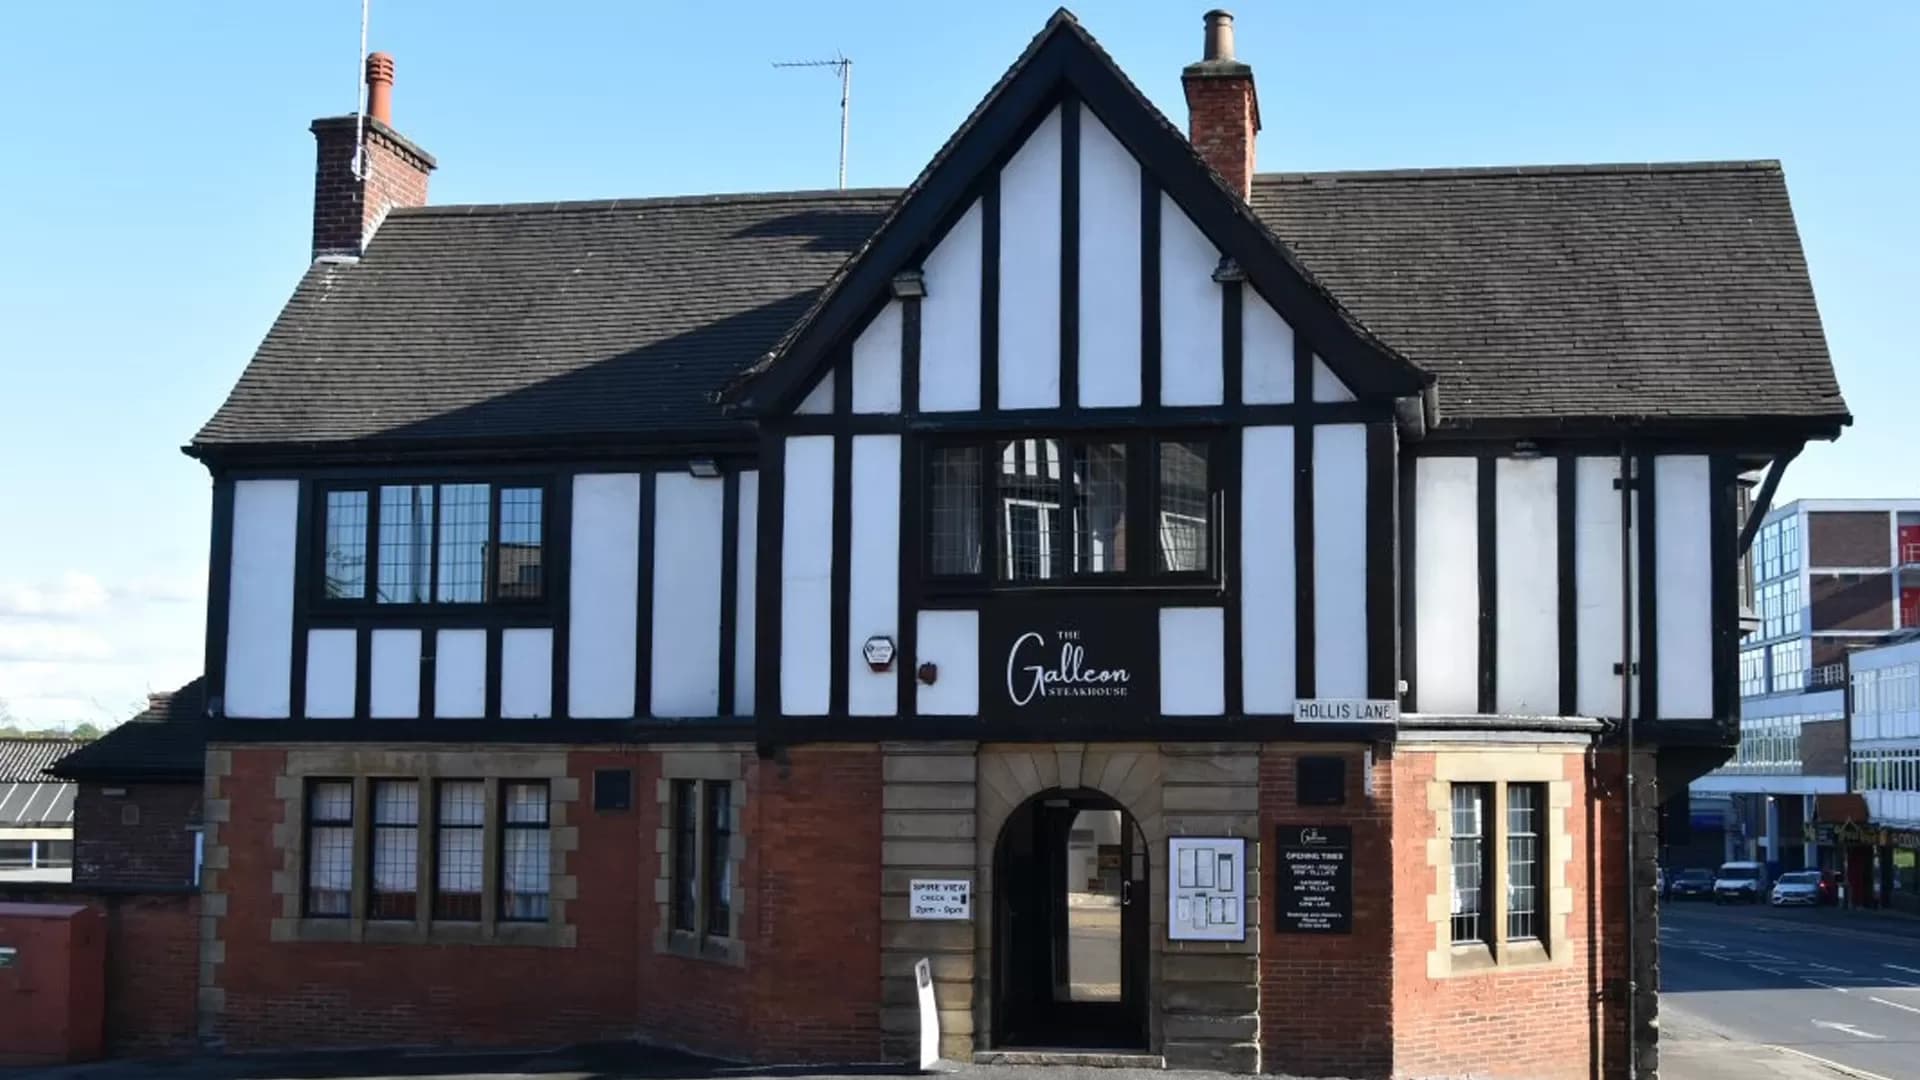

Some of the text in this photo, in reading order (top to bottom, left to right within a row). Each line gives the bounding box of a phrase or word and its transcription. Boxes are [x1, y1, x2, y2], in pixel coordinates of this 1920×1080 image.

[1057, 631, 1080, 640] THE
[1007, 632, 1130, 706] Galleon
[1048, 687, 1128, 696] STEAKHOUSE
[1300, 703, 1391, 719] HOLLIS LANE
[1286, 852, 1320, 860] OPENING
[944, 884, 966, 892] VIEW
